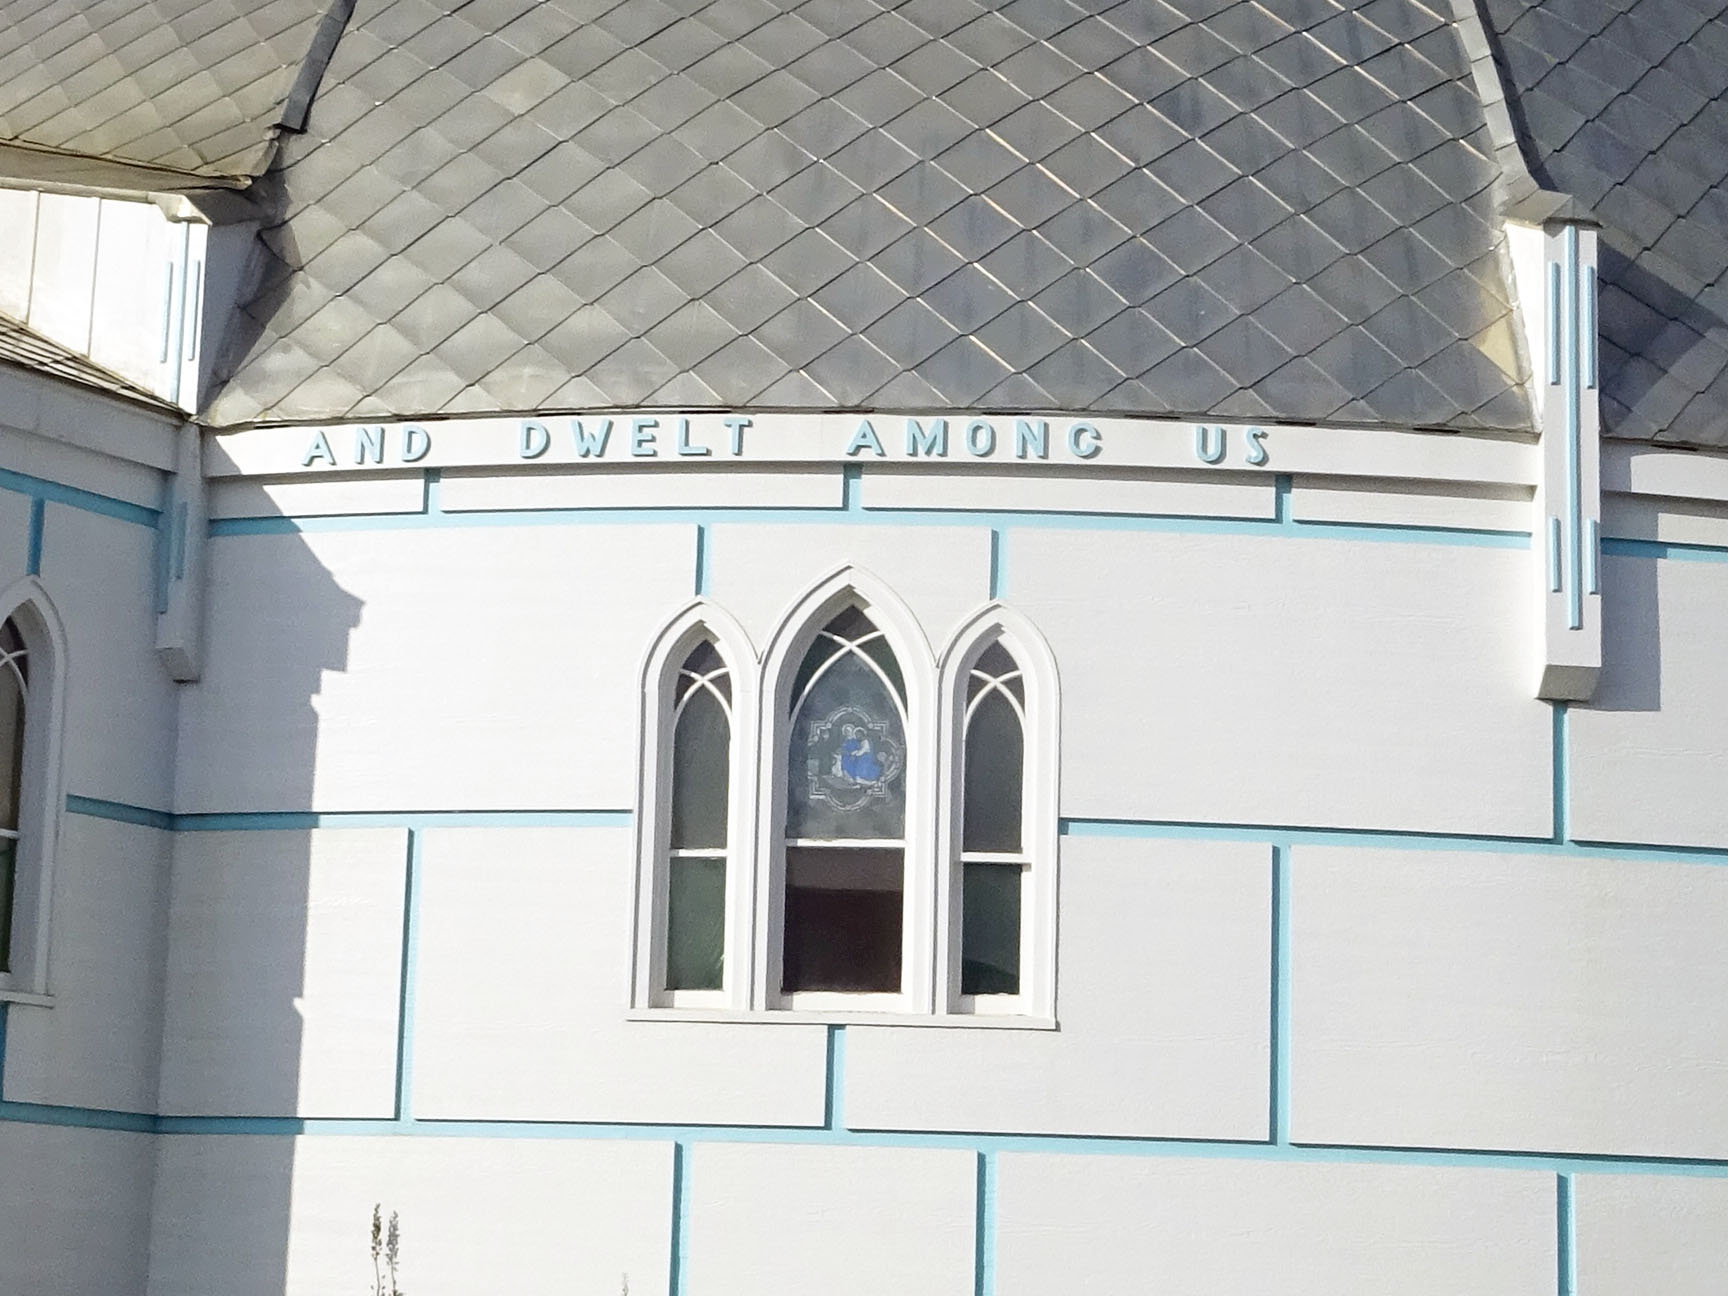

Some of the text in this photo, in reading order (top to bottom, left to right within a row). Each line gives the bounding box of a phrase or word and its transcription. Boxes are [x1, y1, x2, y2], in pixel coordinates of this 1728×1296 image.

[302, 417, 1269, 466] AND DWELT AMONG US
